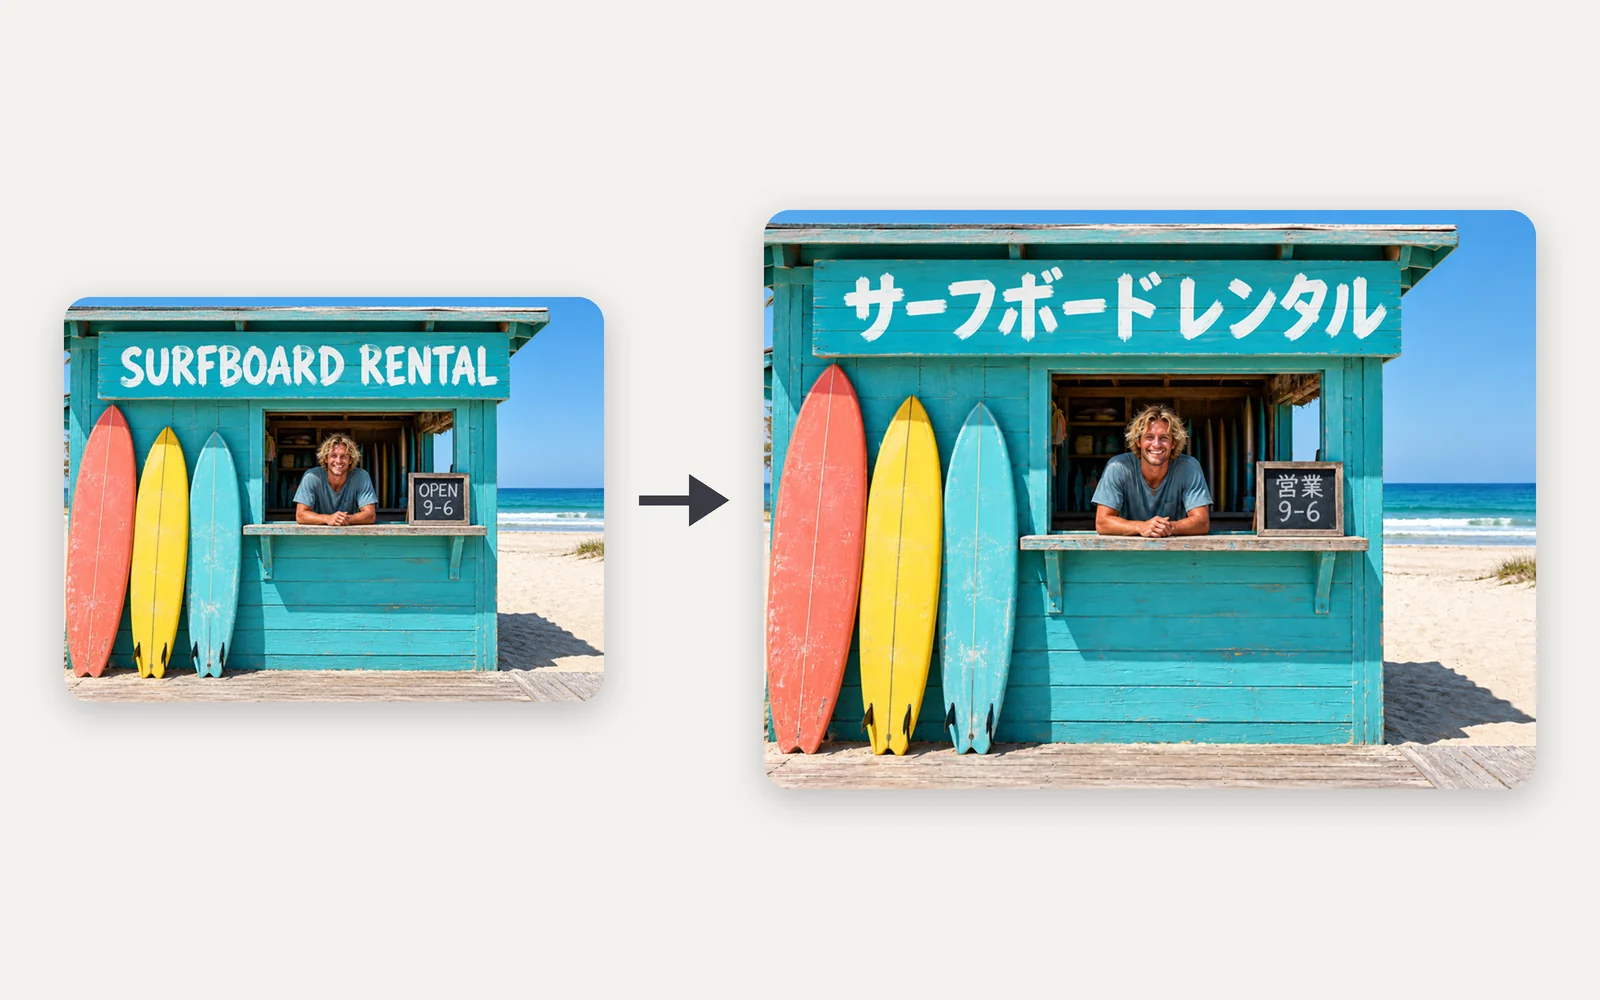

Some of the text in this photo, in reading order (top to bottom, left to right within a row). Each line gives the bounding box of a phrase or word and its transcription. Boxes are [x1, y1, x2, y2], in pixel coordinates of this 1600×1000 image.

[121, 345, 499, 388] SURFBOARD RENTAL
[419, 483, 459, 499] OPEN
[1276, 474, 1325, 500] 営業
[423, 500, 455, 517] 9-6
[1278, 501, 1322, 524] 9-6
